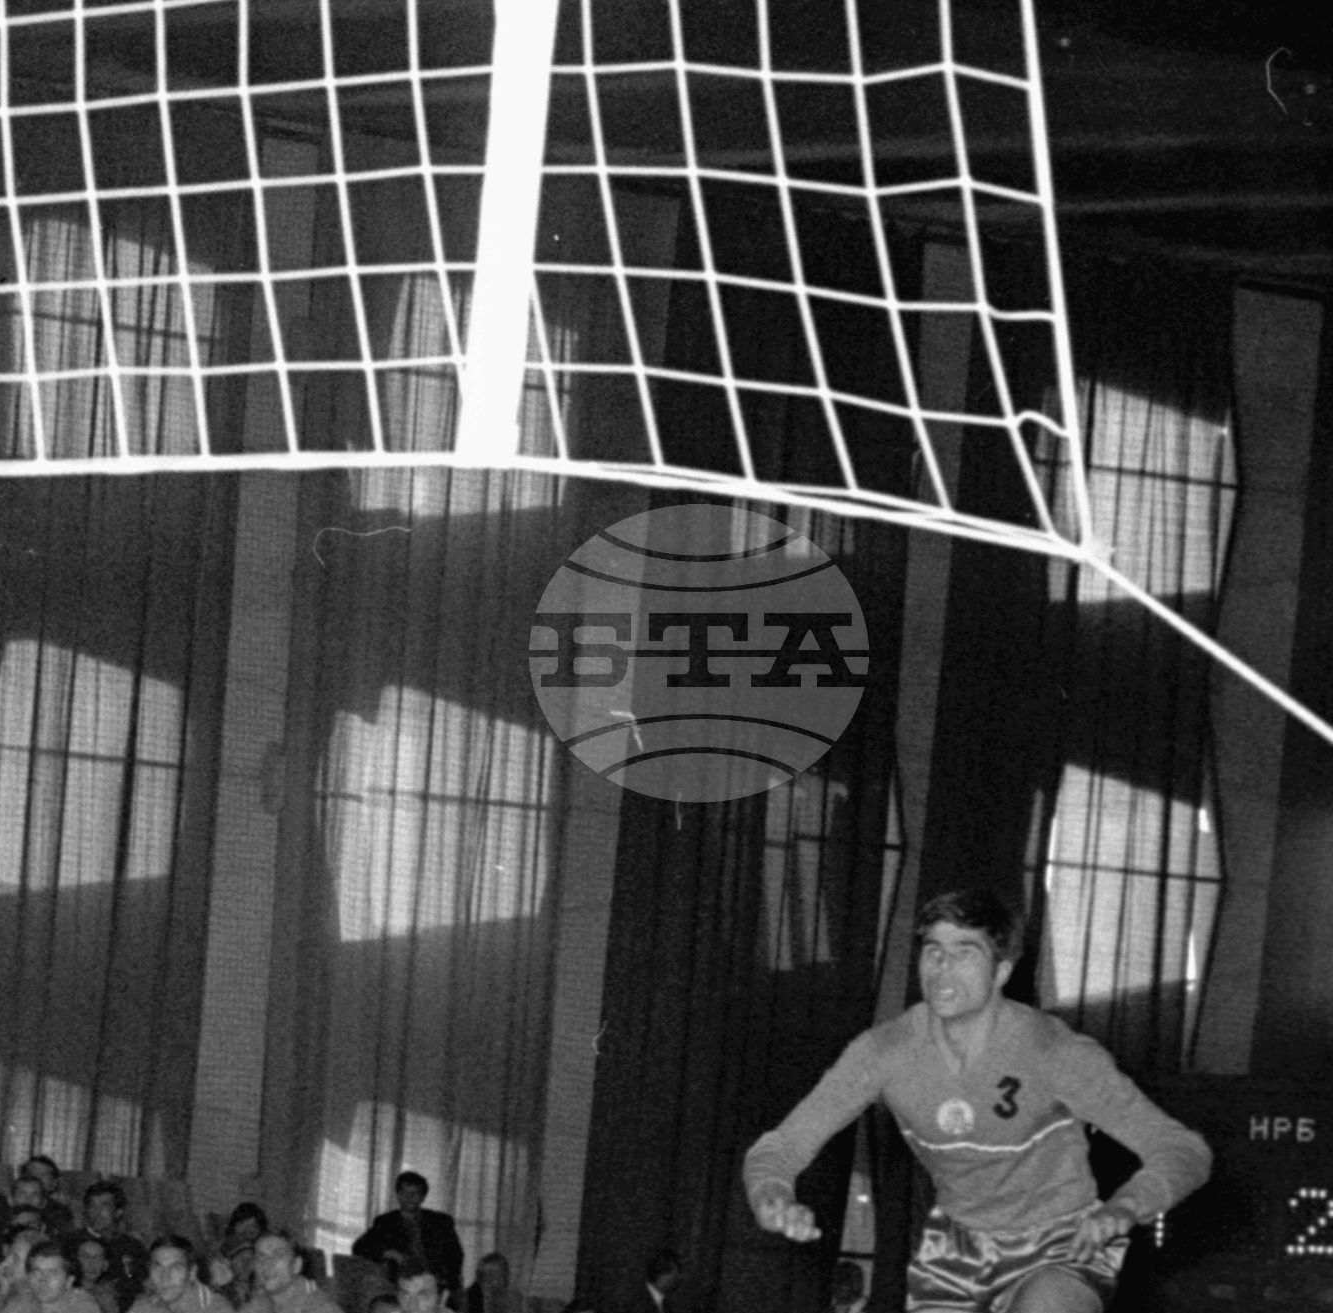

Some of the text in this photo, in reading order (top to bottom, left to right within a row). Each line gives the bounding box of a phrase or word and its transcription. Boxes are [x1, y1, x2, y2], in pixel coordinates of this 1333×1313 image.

[993, 1075, 1022, 1120] 3
[1249, 1116, 1315, 1142] НРБ
[1285, 1188, 1333, 1255] 2
